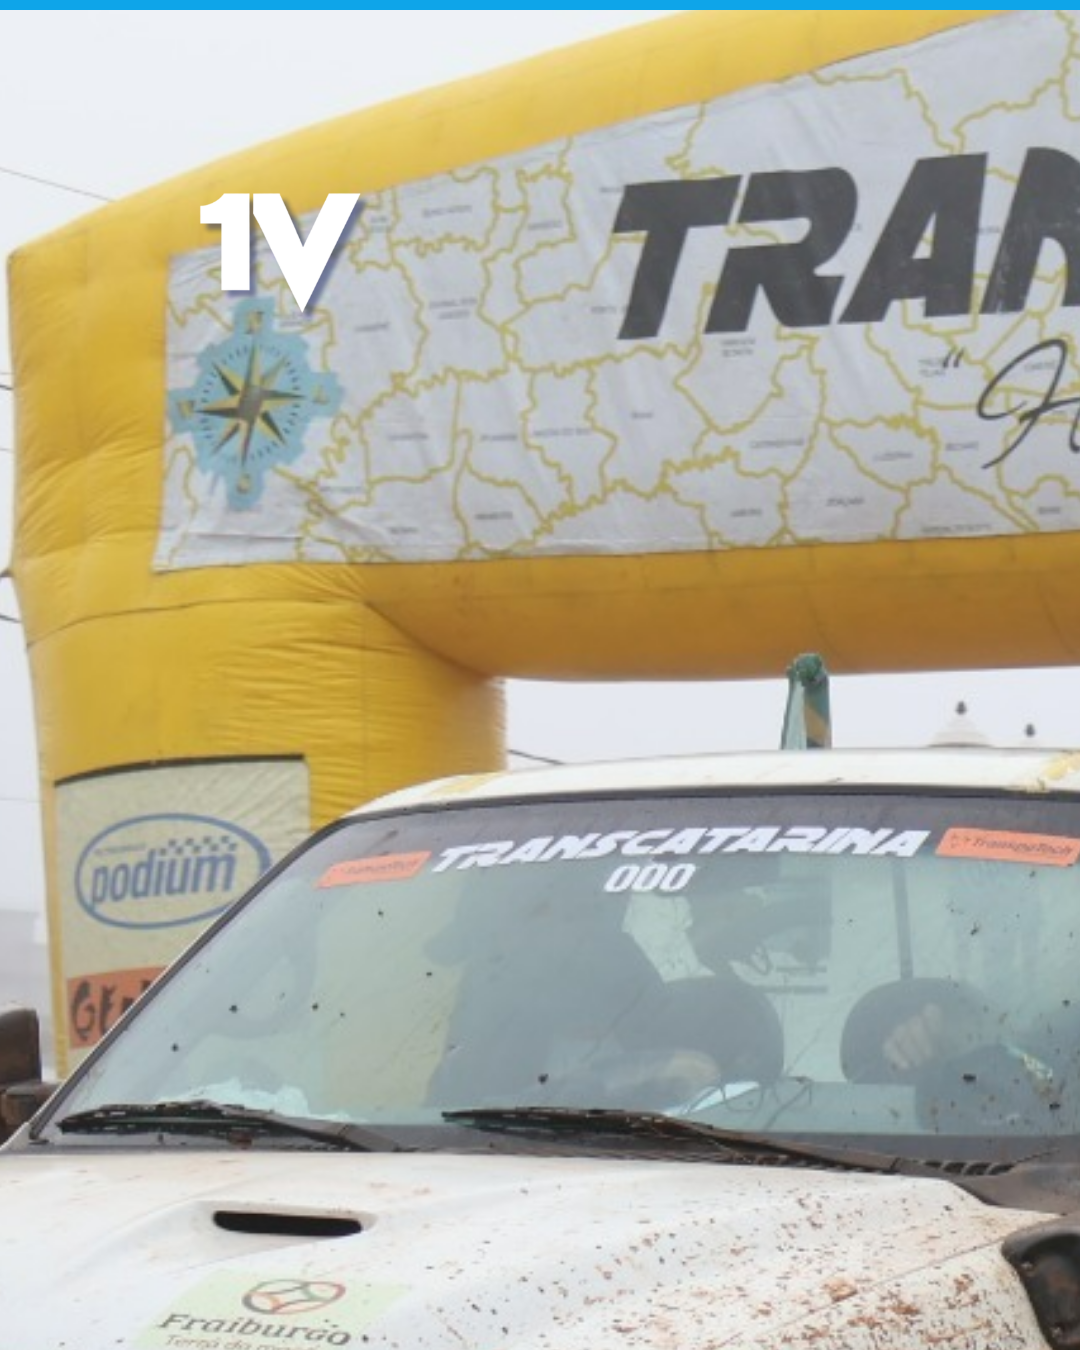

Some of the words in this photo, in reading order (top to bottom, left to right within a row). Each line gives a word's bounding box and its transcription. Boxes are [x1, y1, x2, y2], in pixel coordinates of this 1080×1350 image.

[432, 825, 931, 873] TRANSCATARINA
[90, 848, 238, 905] podium
[603, 863, 697, 892] 000
[158, 1313, 352, 1346] Fraiburgo
